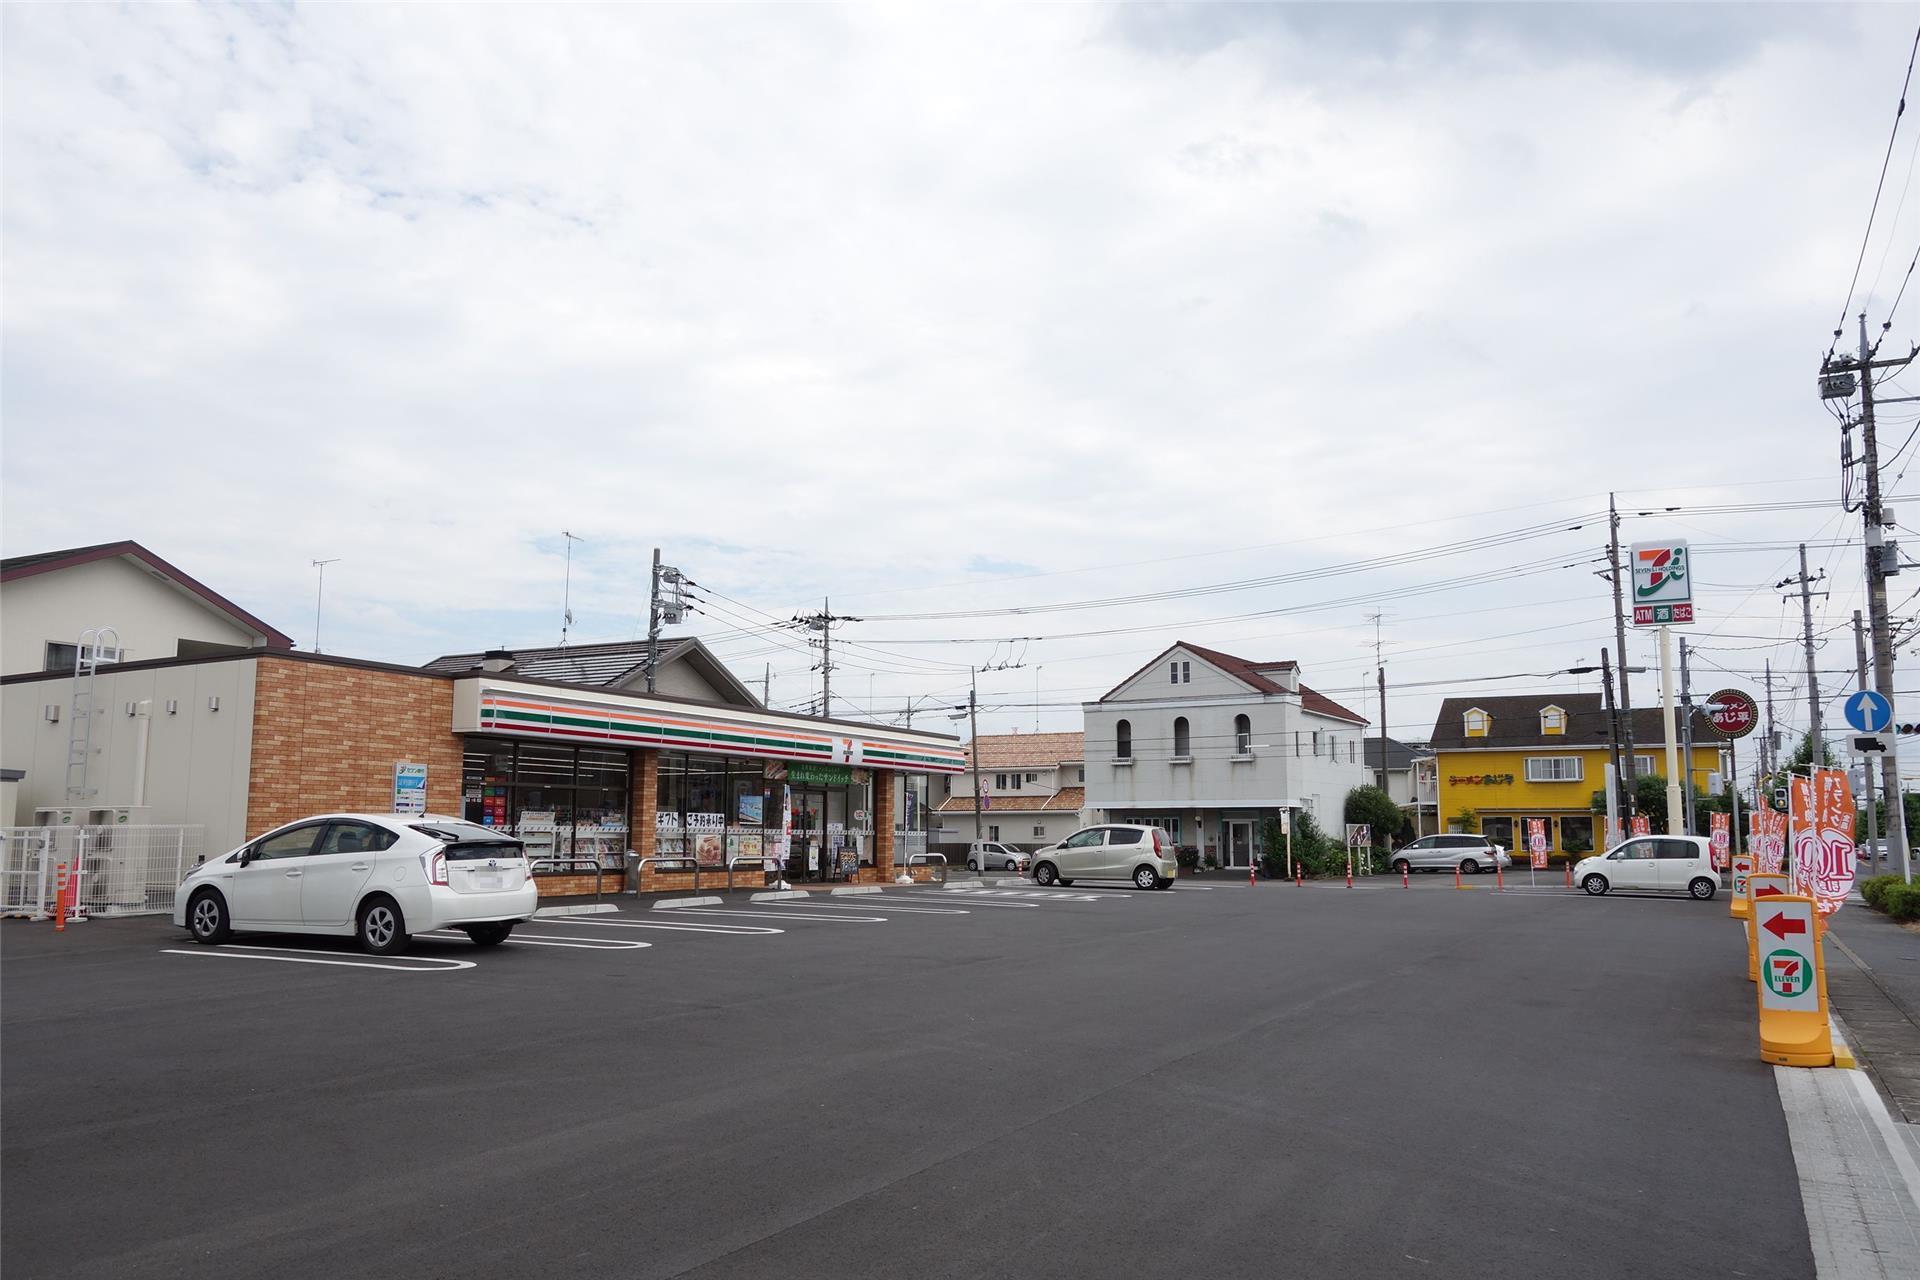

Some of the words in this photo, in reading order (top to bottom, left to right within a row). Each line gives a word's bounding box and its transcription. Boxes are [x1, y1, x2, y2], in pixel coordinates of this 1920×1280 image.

[1635, 609, 1653, 621] ATM
[1656, 608, 1669, 620] 酒
[1673, 607, 1692, 619] たばこ
[1713, 711, 1750, 723] あじ平
[658, 814, 678, 826] ギフト
[688, 813, 724, 828] ご予約承り中
